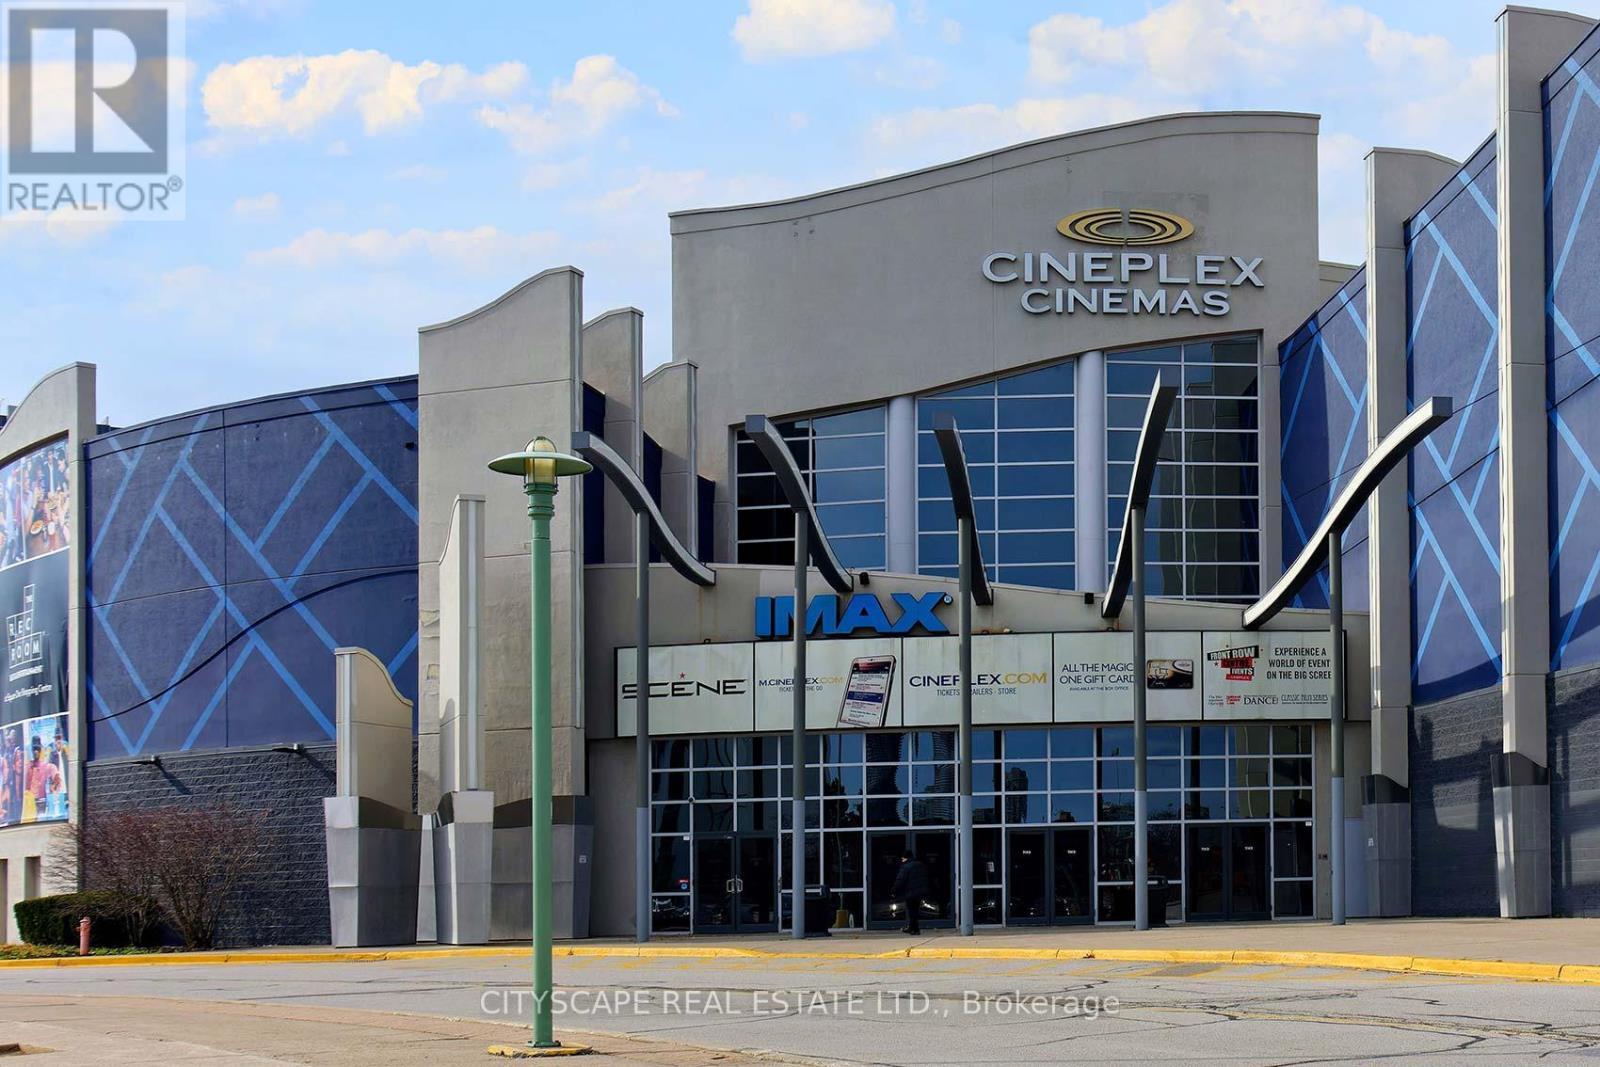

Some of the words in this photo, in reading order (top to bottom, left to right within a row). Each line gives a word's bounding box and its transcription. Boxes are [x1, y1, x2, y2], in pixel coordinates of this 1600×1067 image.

[981, 252, 1265, 287] CINEPLEX
[1020, 288, 1231, 317] CINEMAS
[754, 592, 950, 637] IMAX
[1210, 650, 1231, 660] FRONT
[1232, 646, 1256, 659] ROW
[1274, 647, 1320, 656] EXPERIENCE
[1321, 647, 1327, 656] A
[1062, 664, 1079, 672] ALL
[1080, 664, 1099, 672] THE
[1101, 663, 1134, 671] MAGIC
[1268, 659, 1295, 668] WORLD
[1296, 659, 1306, 668] OF
[1308, 659, 1331, 668] EVENT
[1059, 674, 1082, 684] ONE
[1083, 674, 1106, 684] GIFT
[1266, 671, 1277, 680] ON
[1279, 670, 1293, 680] THE
[1294, 670, 1308, 679] BIG
[1308, 670, 1332, 679] SCREE
[759, 677, 843, 687] M.CINEEX.COM
[971, 688, 993, 696] AILERS
[997, 687, 1017, 695] STORE
